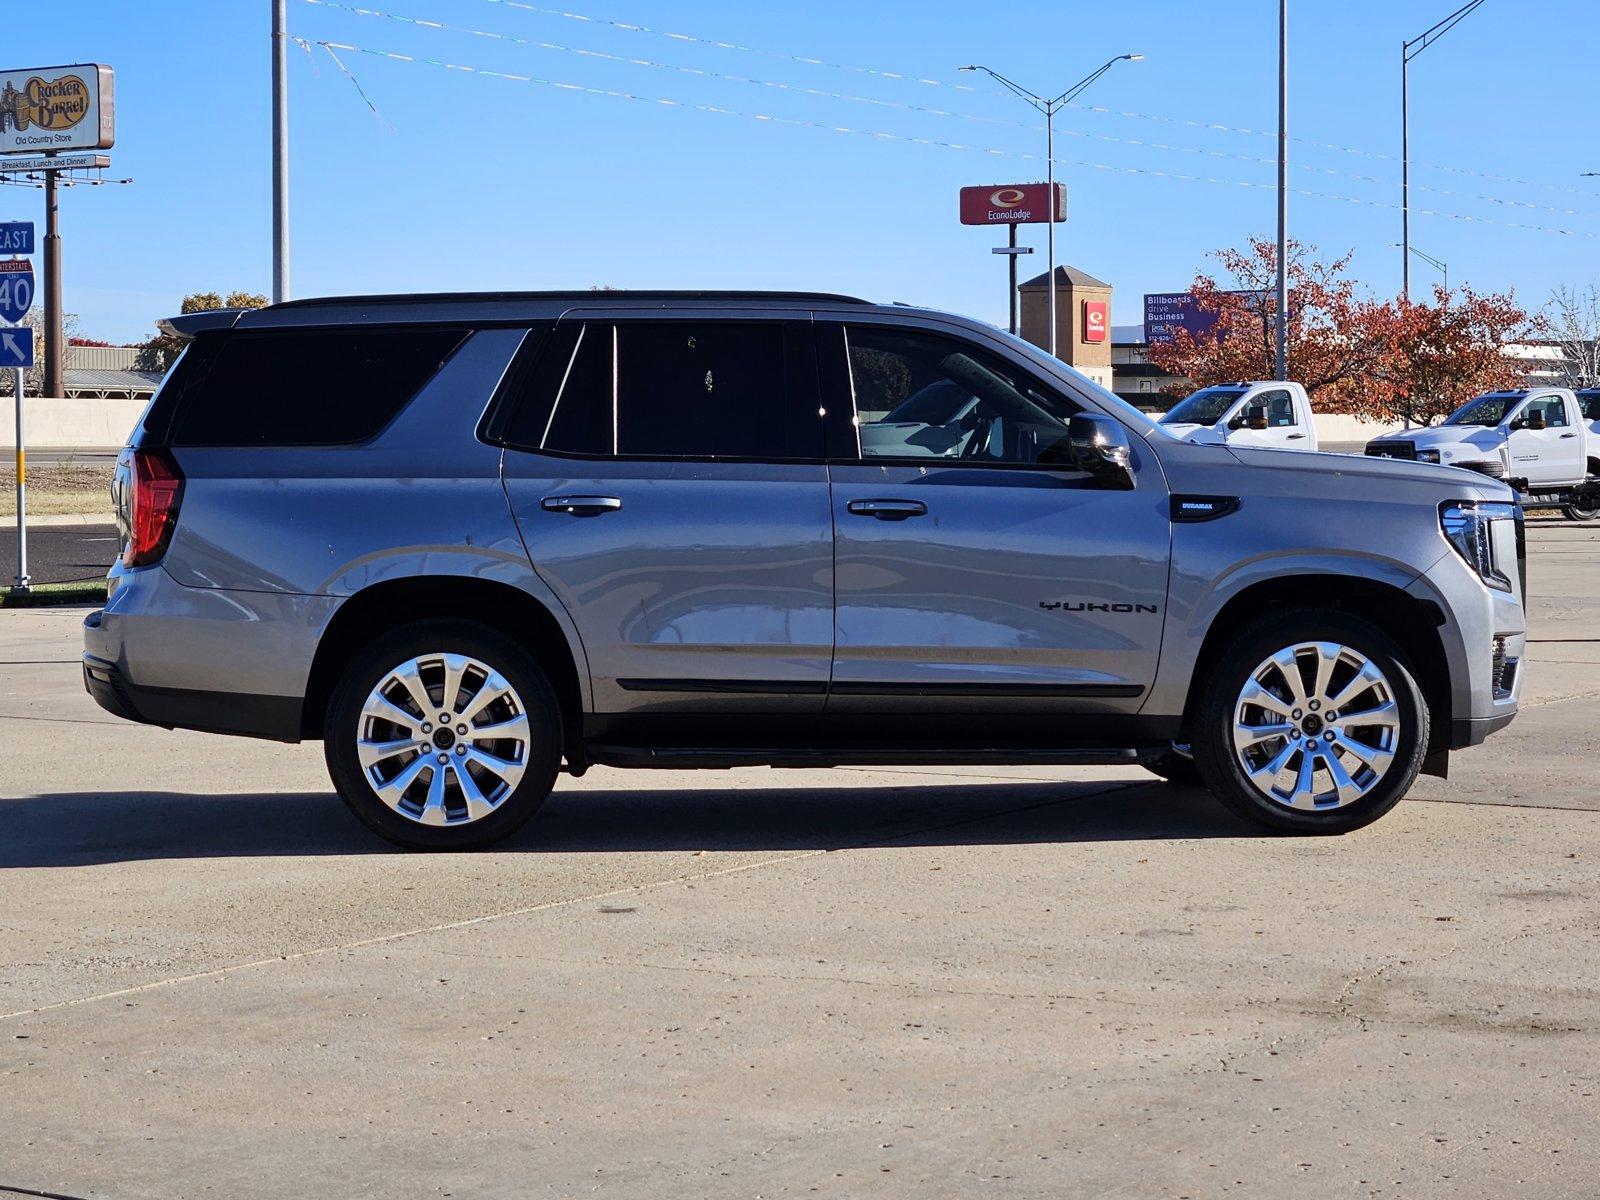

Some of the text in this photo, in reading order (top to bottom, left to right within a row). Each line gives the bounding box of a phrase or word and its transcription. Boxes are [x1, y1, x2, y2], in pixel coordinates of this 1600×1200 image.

[25, 80, 81, 108] Cracker
[38, 97, 84, 127] Barrel
[15, 134, 72, 145] Old Country Store
[66, 158, 87, 166] Dinner
[0, 262, 28, 271] NTERSTATE
[0, 278, 30, 311] 40
[1147, 296, 1191, 304] Billboards
[1147, 304, 1169, 312] drive
[1148, 312, 1185, 321] Business
[1039, 602, 1158, 613] YUKON
